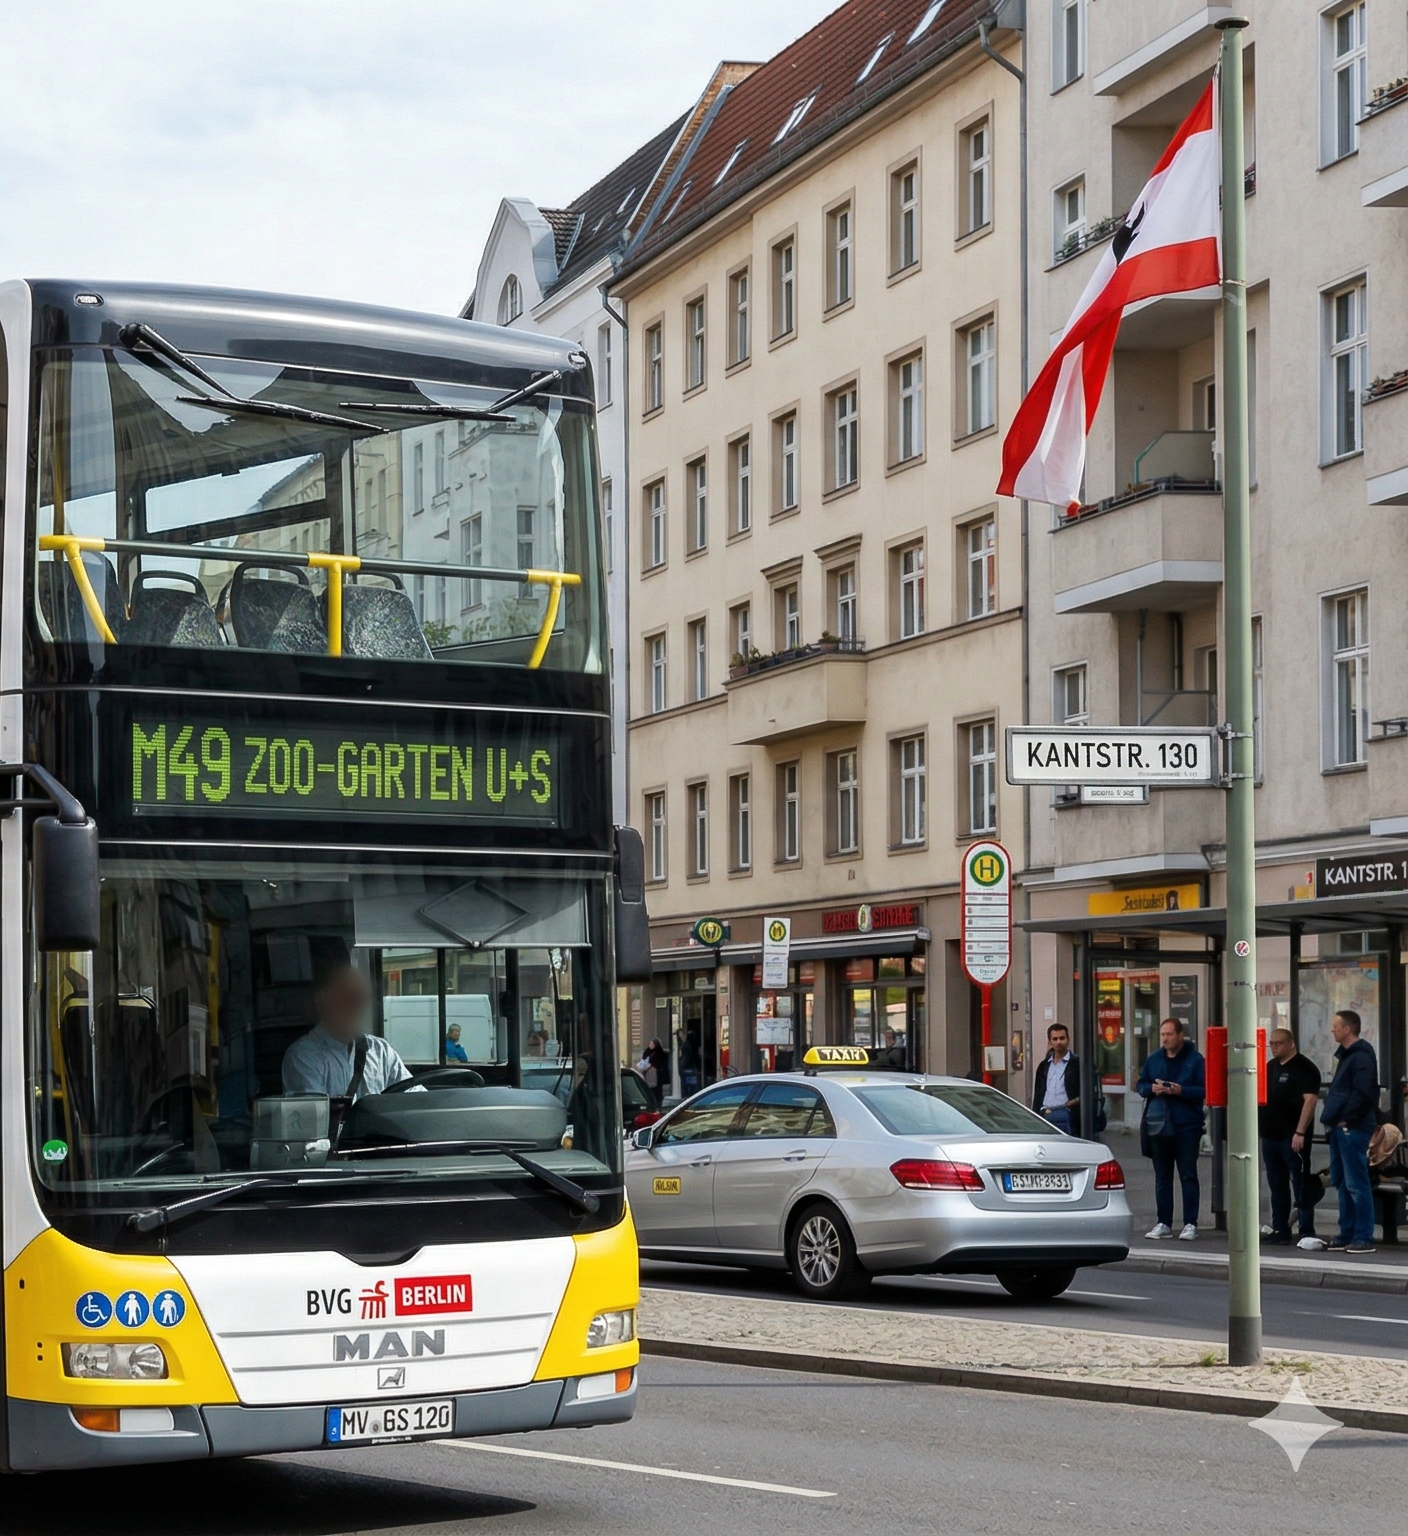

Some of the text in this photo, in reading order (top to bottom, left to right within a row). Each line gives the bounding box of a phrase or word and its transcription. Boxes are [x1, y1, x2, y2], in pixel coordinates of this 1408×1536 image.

[133, 723, 551, 803] M49 ZOO-GARTEN U+S
[1027, 742, 1198, 769] KANTSTR. 130
[980, 859, 994, 878] H
[1325, 862, 1398, 886] KANTSTR.
[307, 1284, 466, 1316] BVG BERLIN
[333, 1329, 445, 1362] MAN
[342, 1410, 369, 1436] MV
[413, 1405, 450, 1430] 120
